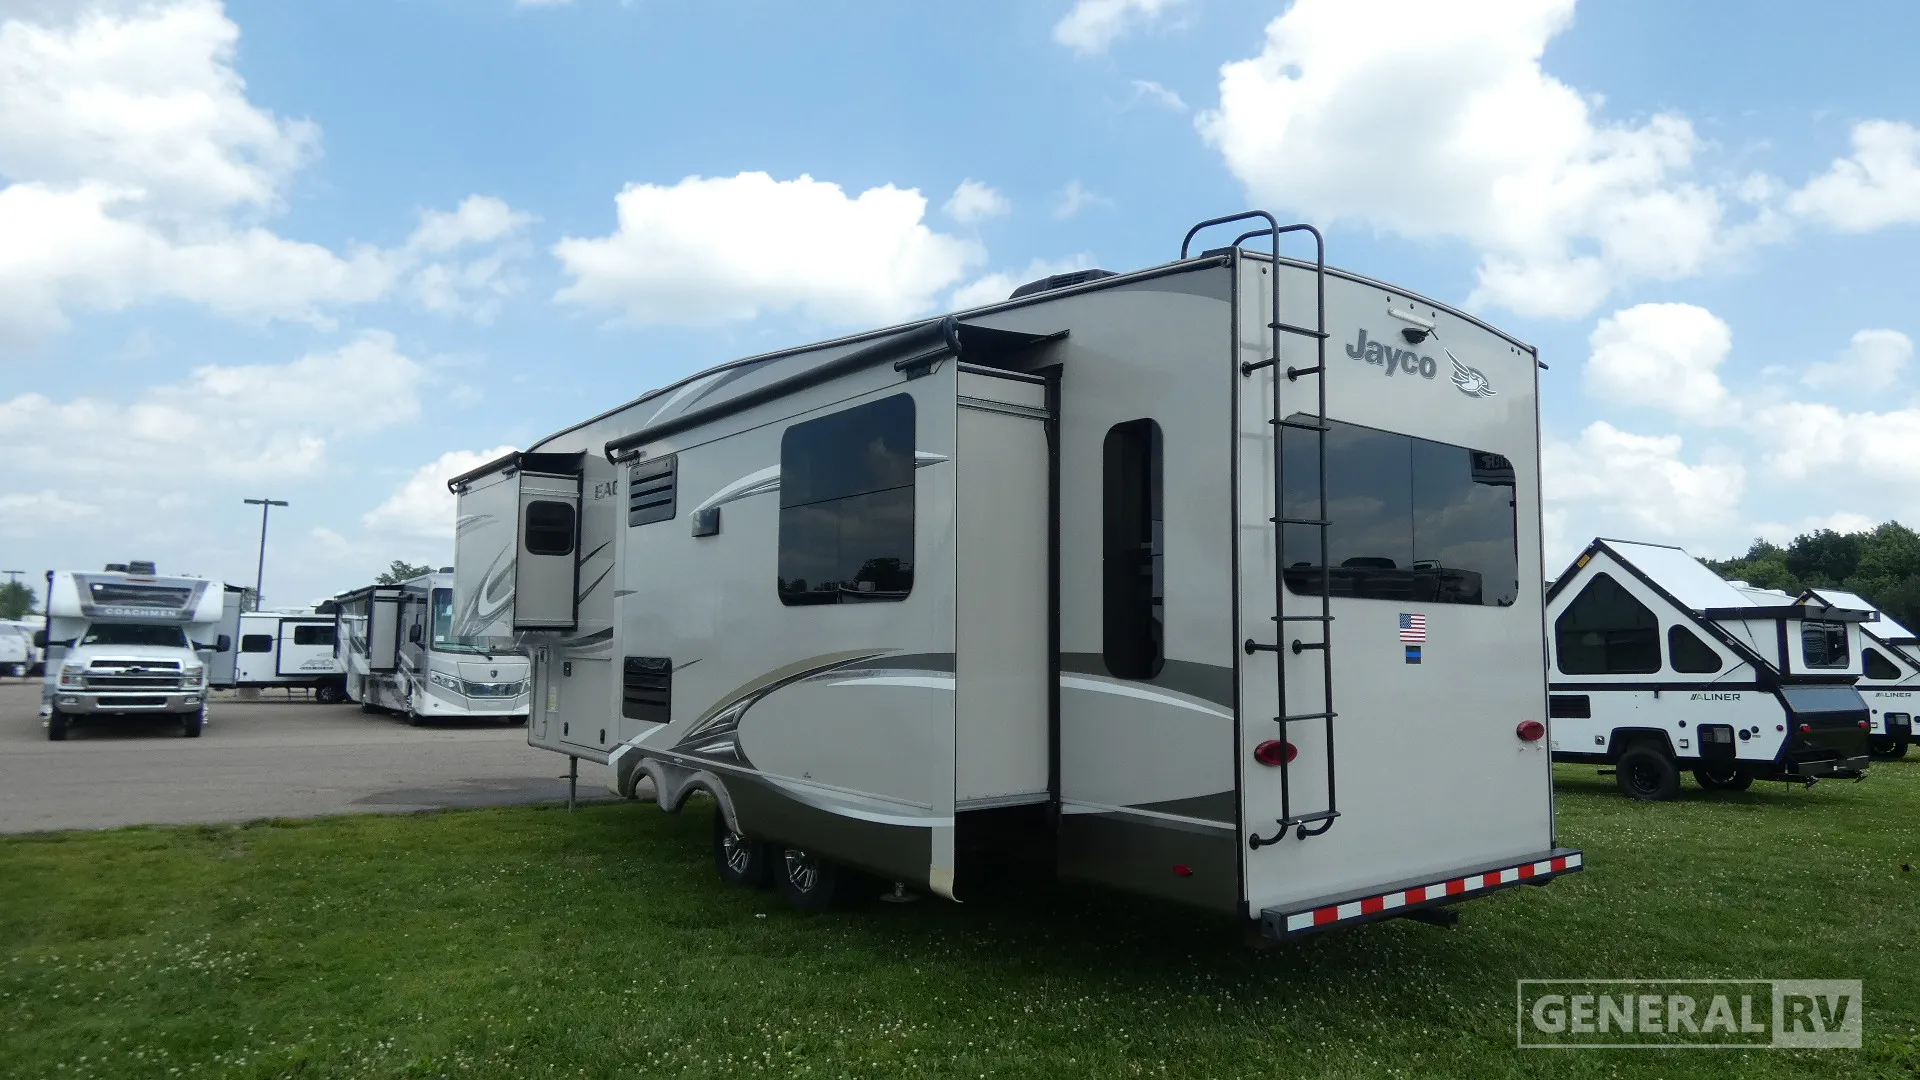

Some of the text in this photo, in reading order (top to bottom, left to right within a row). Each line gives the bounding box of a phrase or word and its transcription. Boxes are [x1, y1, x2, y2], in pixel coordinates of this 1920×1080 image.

[1345, 328, 1437, 380] Jayco
[104, 608, 176, 617] COACHMEN
[1693, 693, 1741, 701] ALINER
